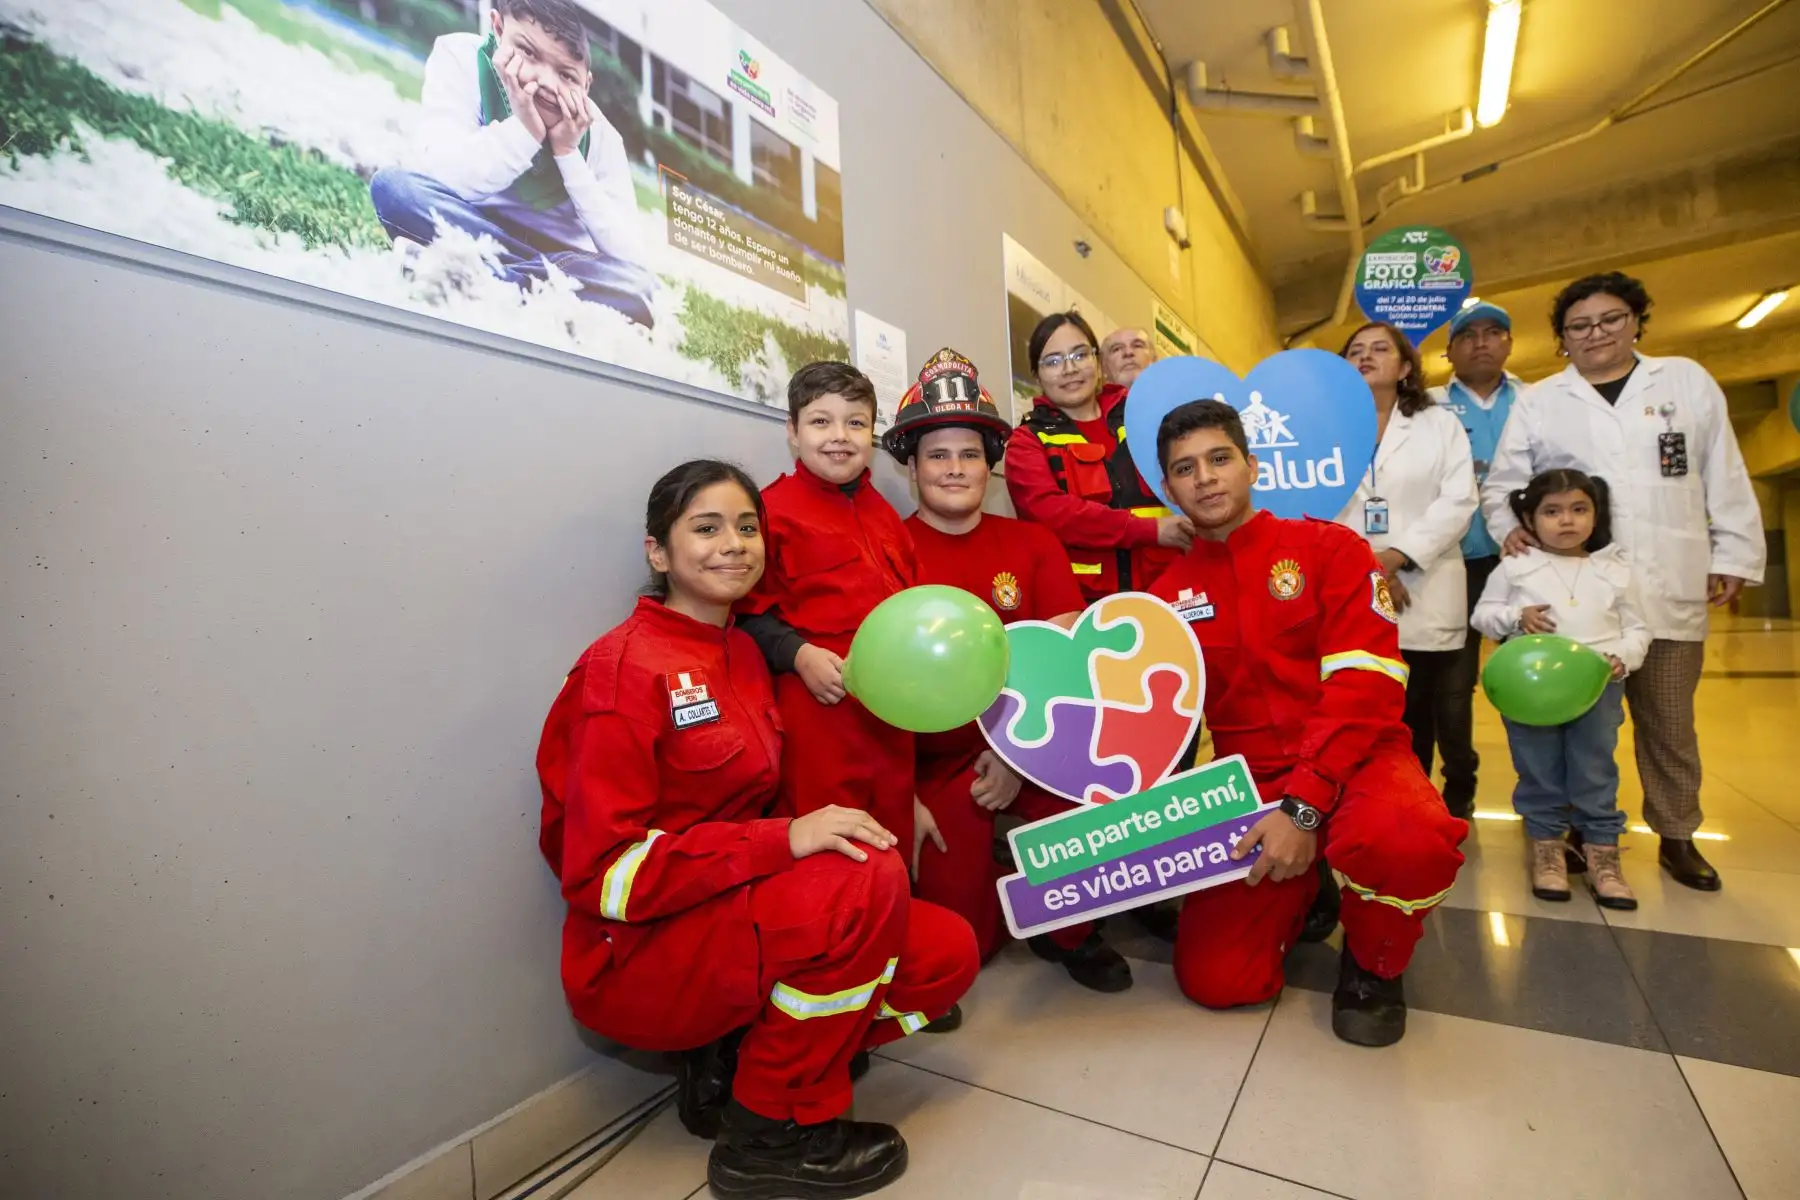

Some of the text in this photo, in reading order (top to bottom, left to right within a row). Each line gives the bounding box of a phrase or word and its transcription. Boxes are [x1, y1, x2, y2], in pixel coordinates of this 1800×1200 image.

[672, 185, 726, 222] Soy César,
[672, 200, 789, 265] tengo 12 años. Espero un
[674, 216, 802, 283] donante y cumplir mi sueño
[674, 231, 755, 276] de ser bombero.
[1365, 264, 1417, 279] FOTO
[1375, 303, 1446, 313] ESTACIÓN CENTRAL
[1377, 296, 1390, 305] del
[1390, 296, 1396, 304] 7
[1397, 296, 1405, 304] al
[1417, 296, 1428, 304] de
[1428, 295, 1447, 304] julio
[924, 361, 972, 378] COSMOPOLITA
[934, 376, 969, 404] 11
[1251, 446, 1346, 492] alud
[674, 687, 704, 698] BOMBEROS
[679, 712, 686, 723] A.
[1027, 774, 1246, 869] Una parte de mí,
[1043, 882, 1081, 911] es
[1082, 861, 1152, 899] vida
[1153, 840, 1228, 886] para
